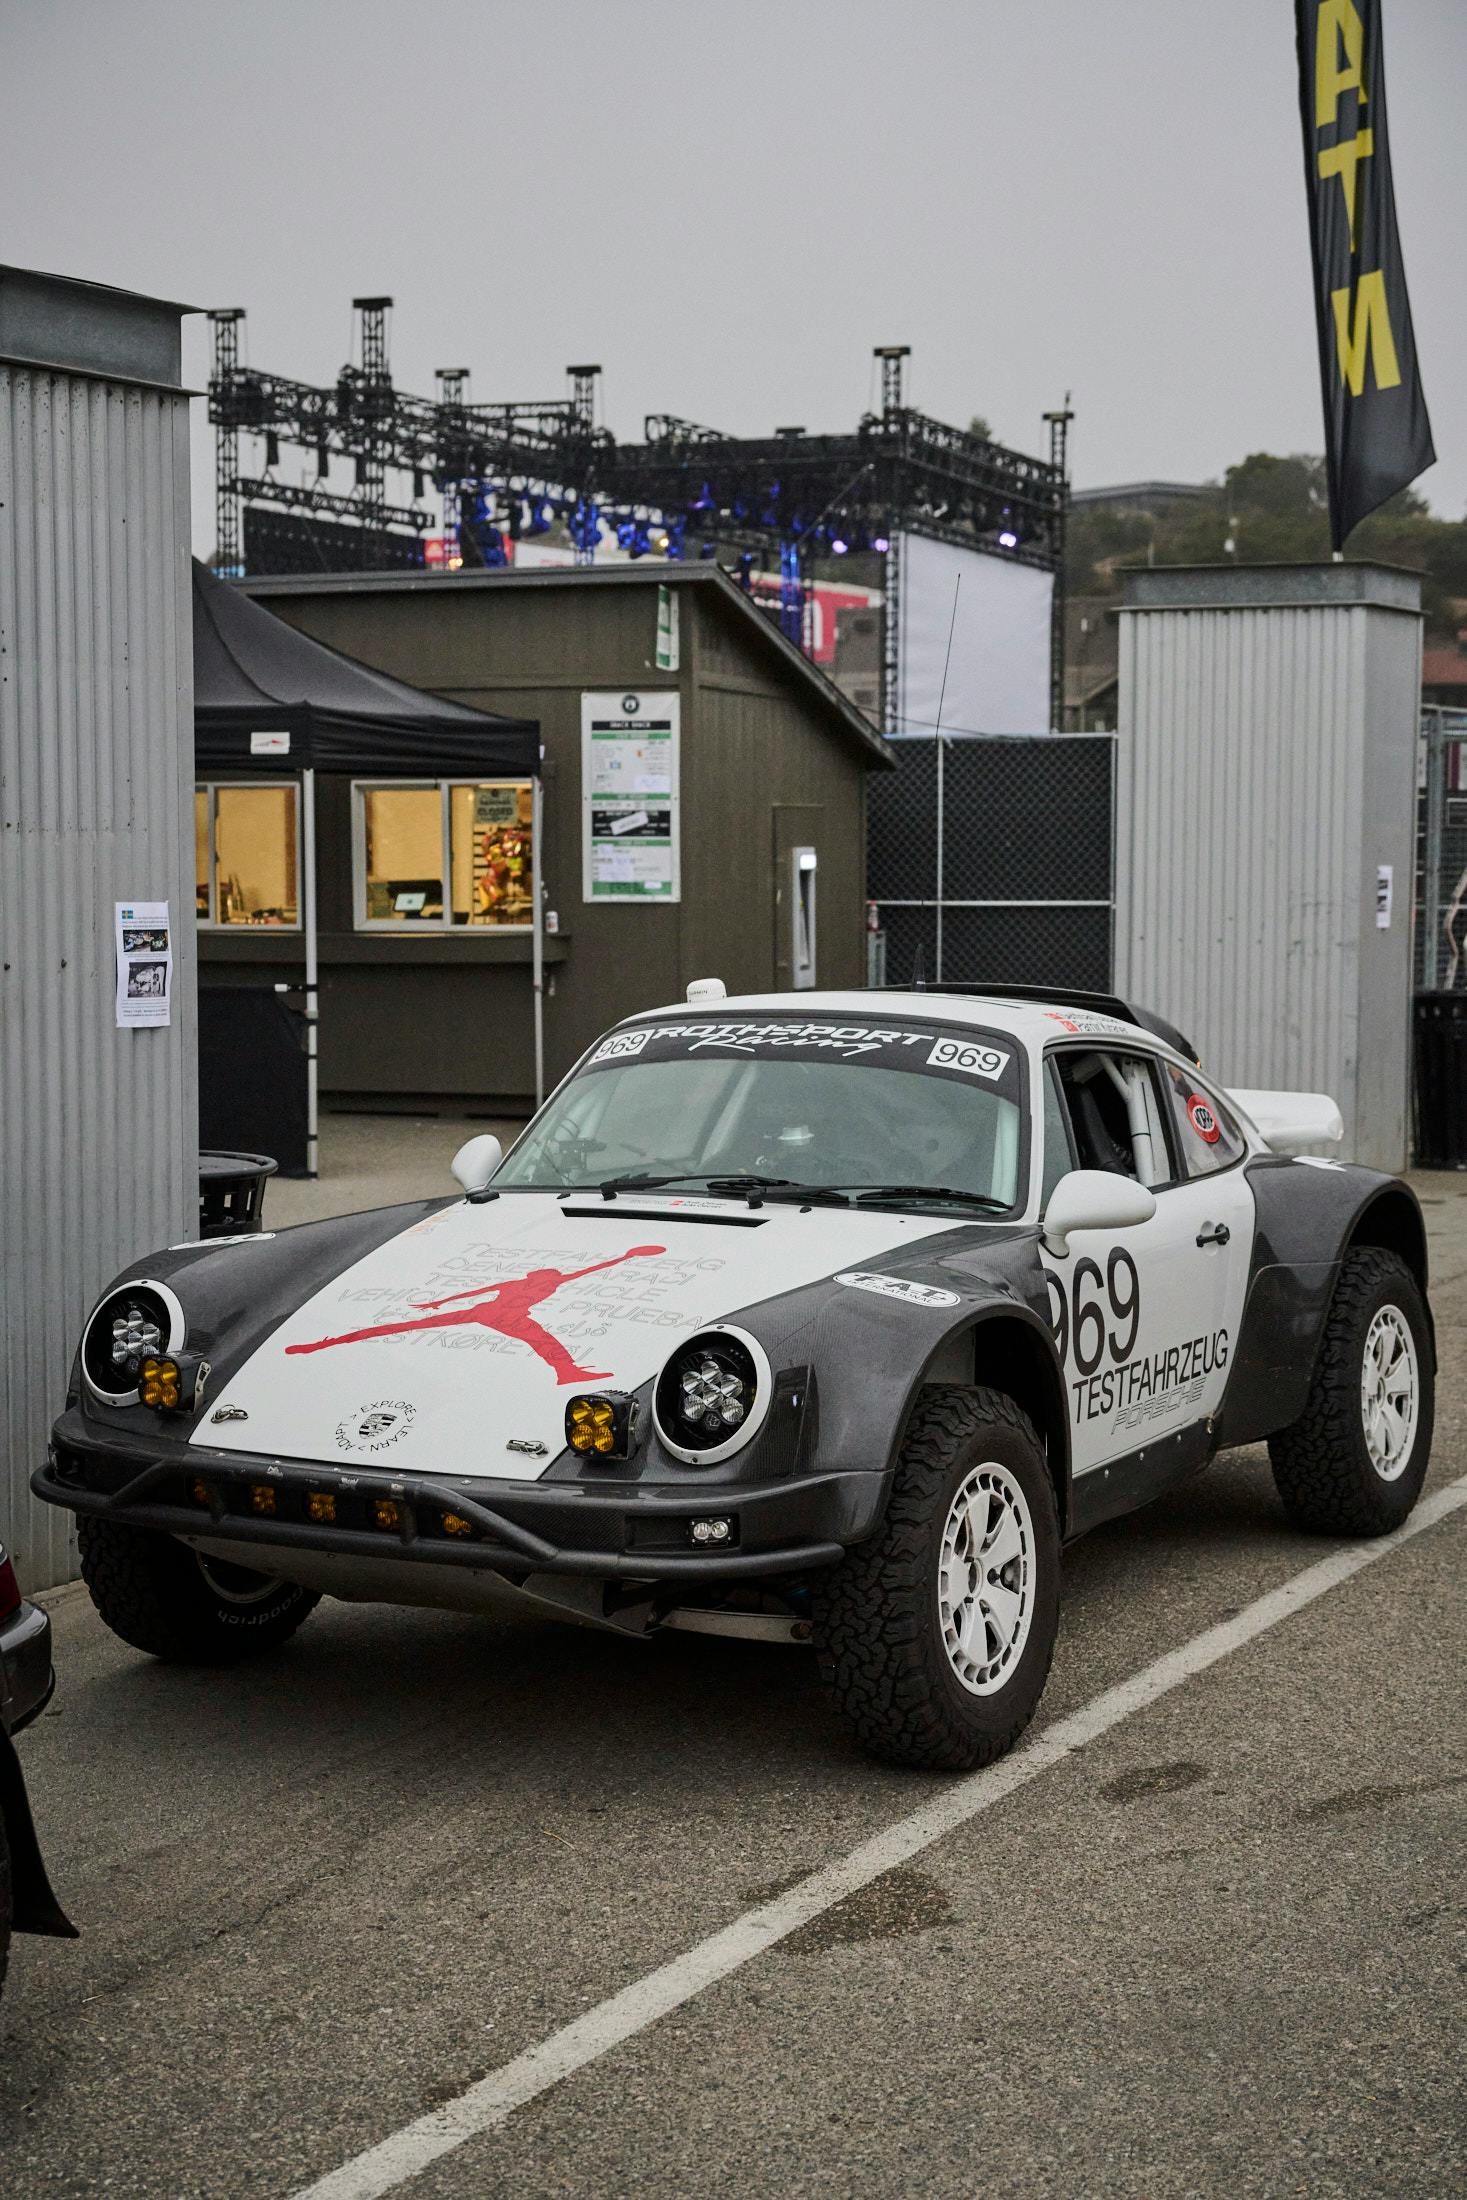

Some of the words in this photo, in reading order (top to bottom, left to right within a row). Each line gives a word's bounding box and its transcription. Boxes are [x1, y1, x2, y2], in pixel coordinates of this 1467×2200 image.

[599, 1032, 646, 1058] 969
[653, 1023, 936, 1046] ROTHSPORT
[933, 1042, 1002, 1073] 969
[688, 1034, 885, 1057] Racing
[461, 1242, 726, 1272] TESTFAHZEUG
[846, 1279, 934, 1304] INTERNATIONAL
[558, 1300, 703, 1331] PRUEBA
[1044, 1245, 1140, 1377] 969
[1072, 1328, 1230, 1424] TESTFAHRZEUG
[360, 1400, 417, 1416] EXPLORE
[1110, 1376, 1206, 1436] PORSCHE
[335, 1421, 355, 1451] ADAPT
[370, 1425, 415, 1452] LEARN
